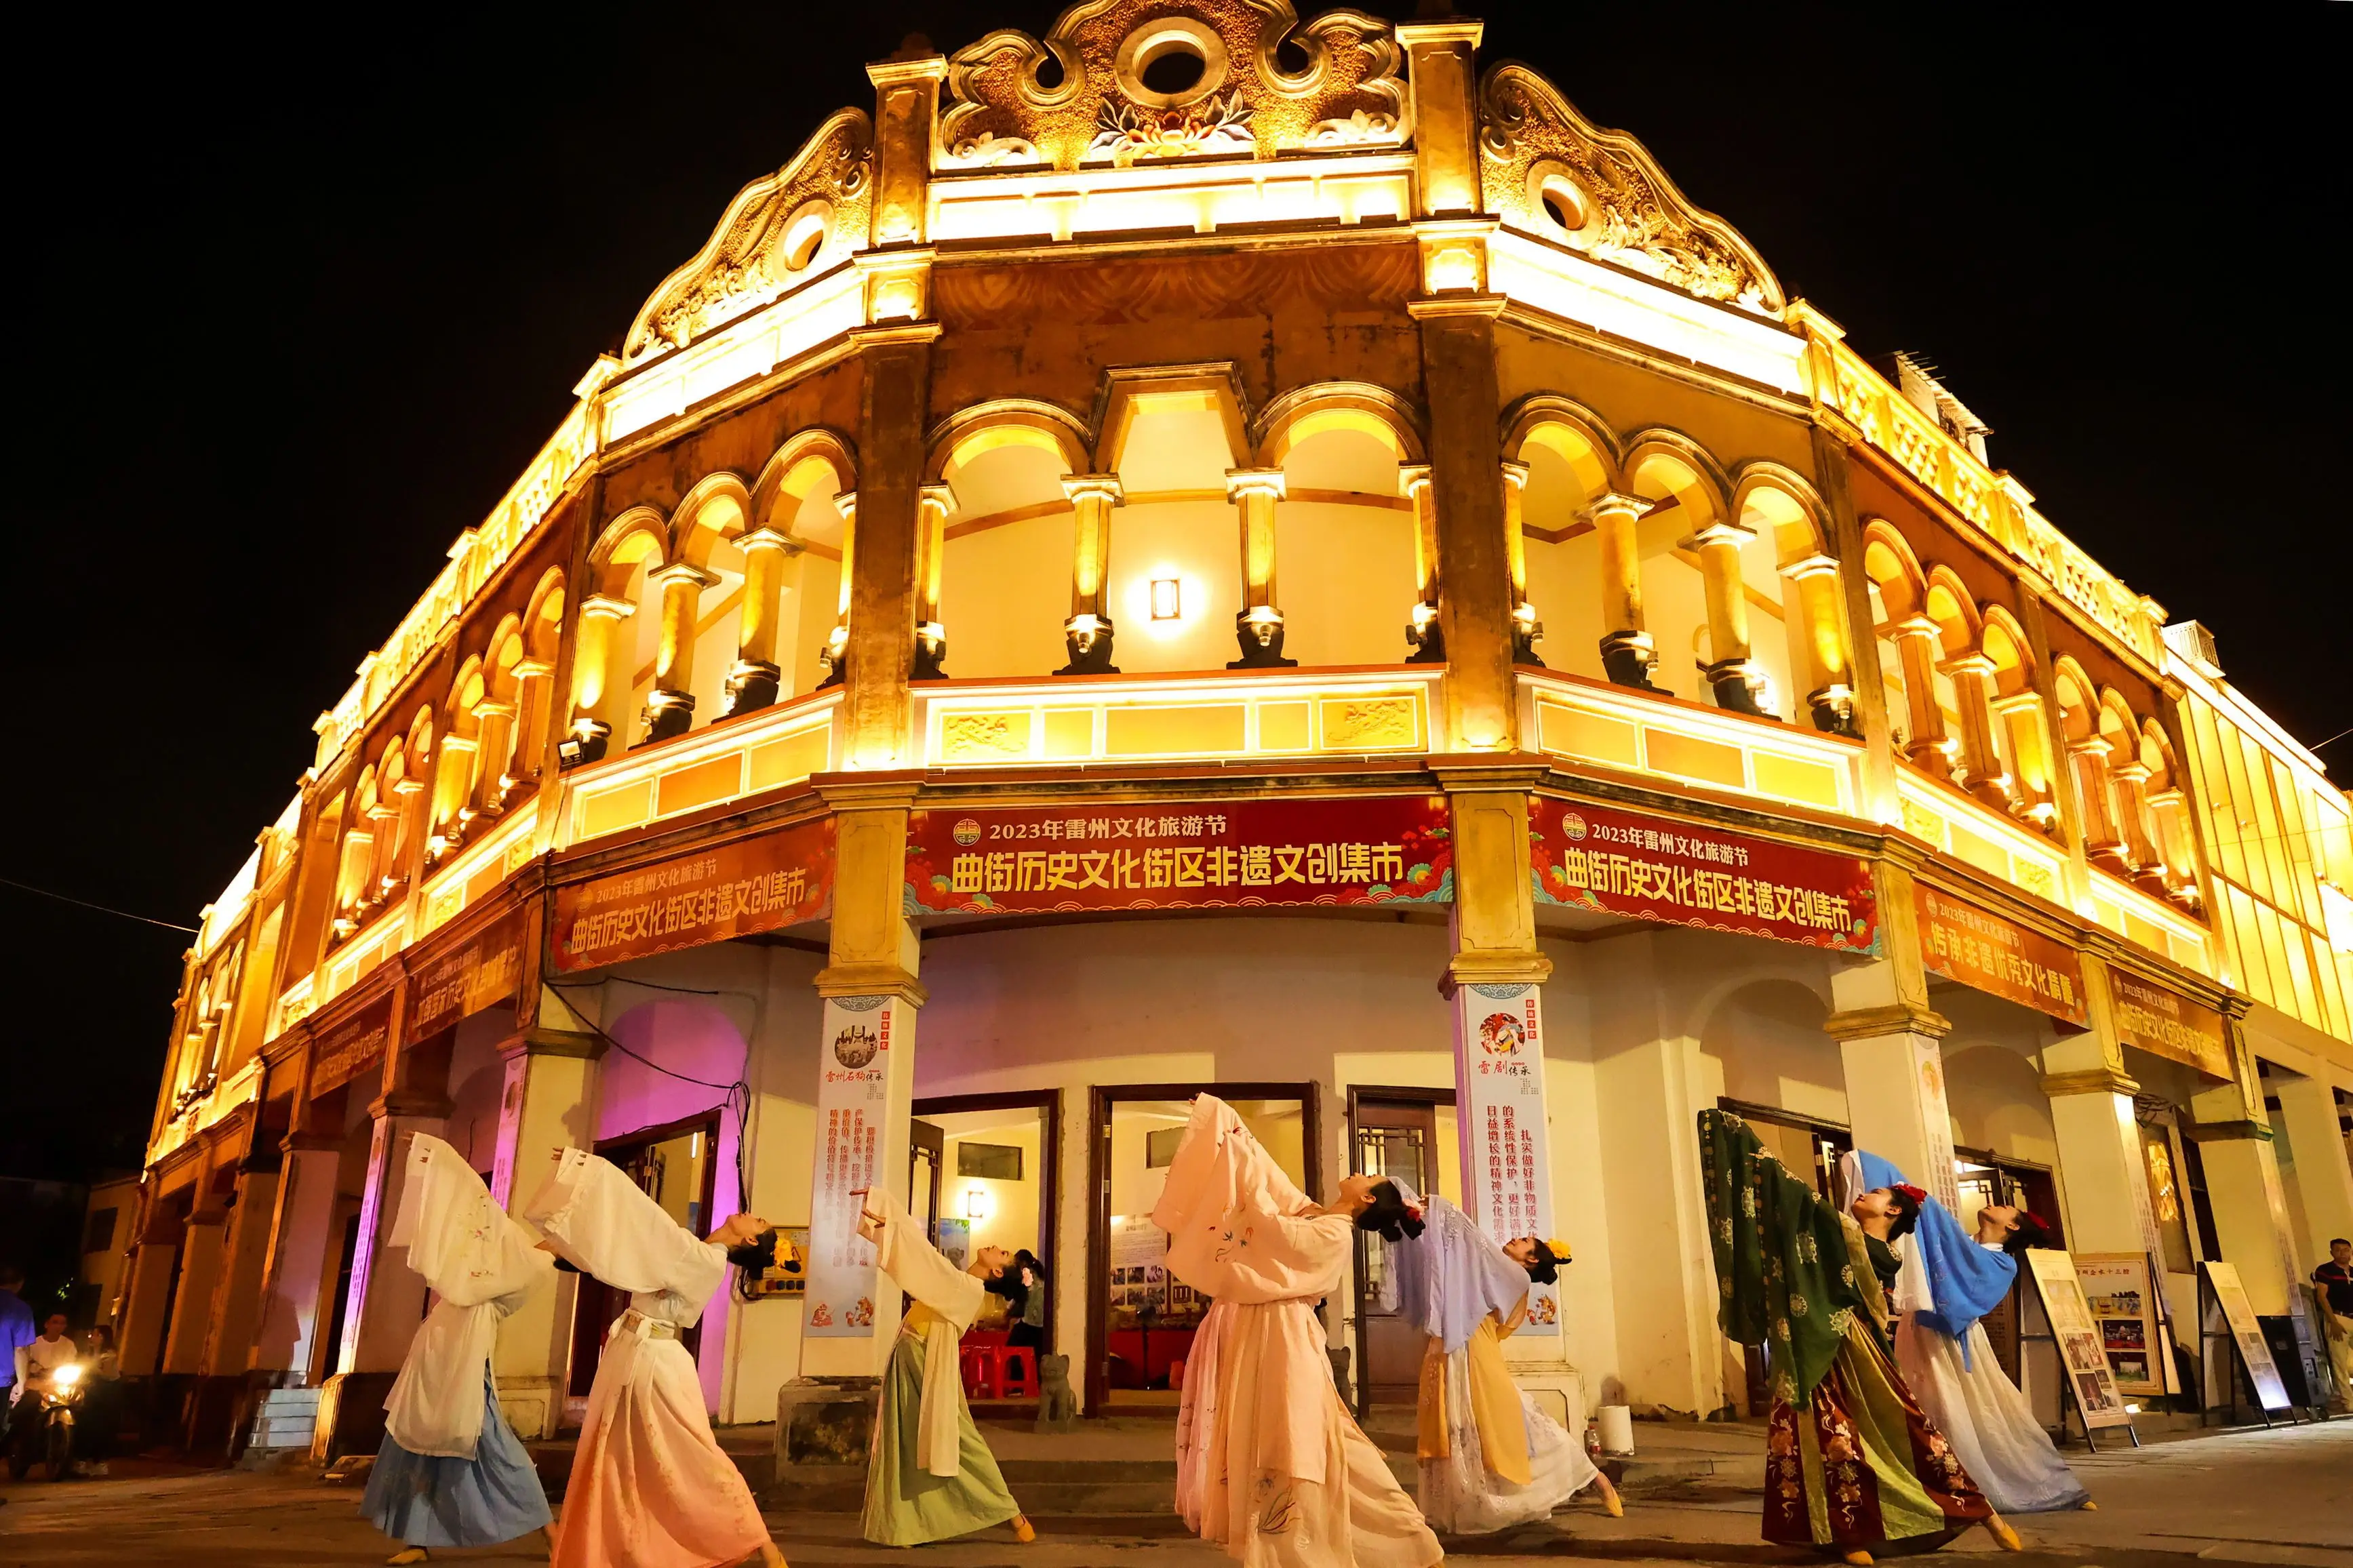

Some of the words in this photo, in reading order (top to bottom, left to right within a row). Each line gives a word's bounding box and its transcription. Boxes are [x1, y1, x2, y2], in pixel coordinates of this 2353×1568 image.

[989, 814, 1227, 841] 2023年雷州文化旅游节
[1592, 823, 1749, 867] 2023年雷州文化旅游节
[596, 858, 717, 904] 2023年雷州文化旅游节
[952, 841, 1404, 893] 曲街历史文化街区非遗文创集市
[1564, 847, 1853, 933] 曲街历史文化街区非遗文创集市
[570, 866, 806, 954] 曲街历史文化街区非遗文创集市
